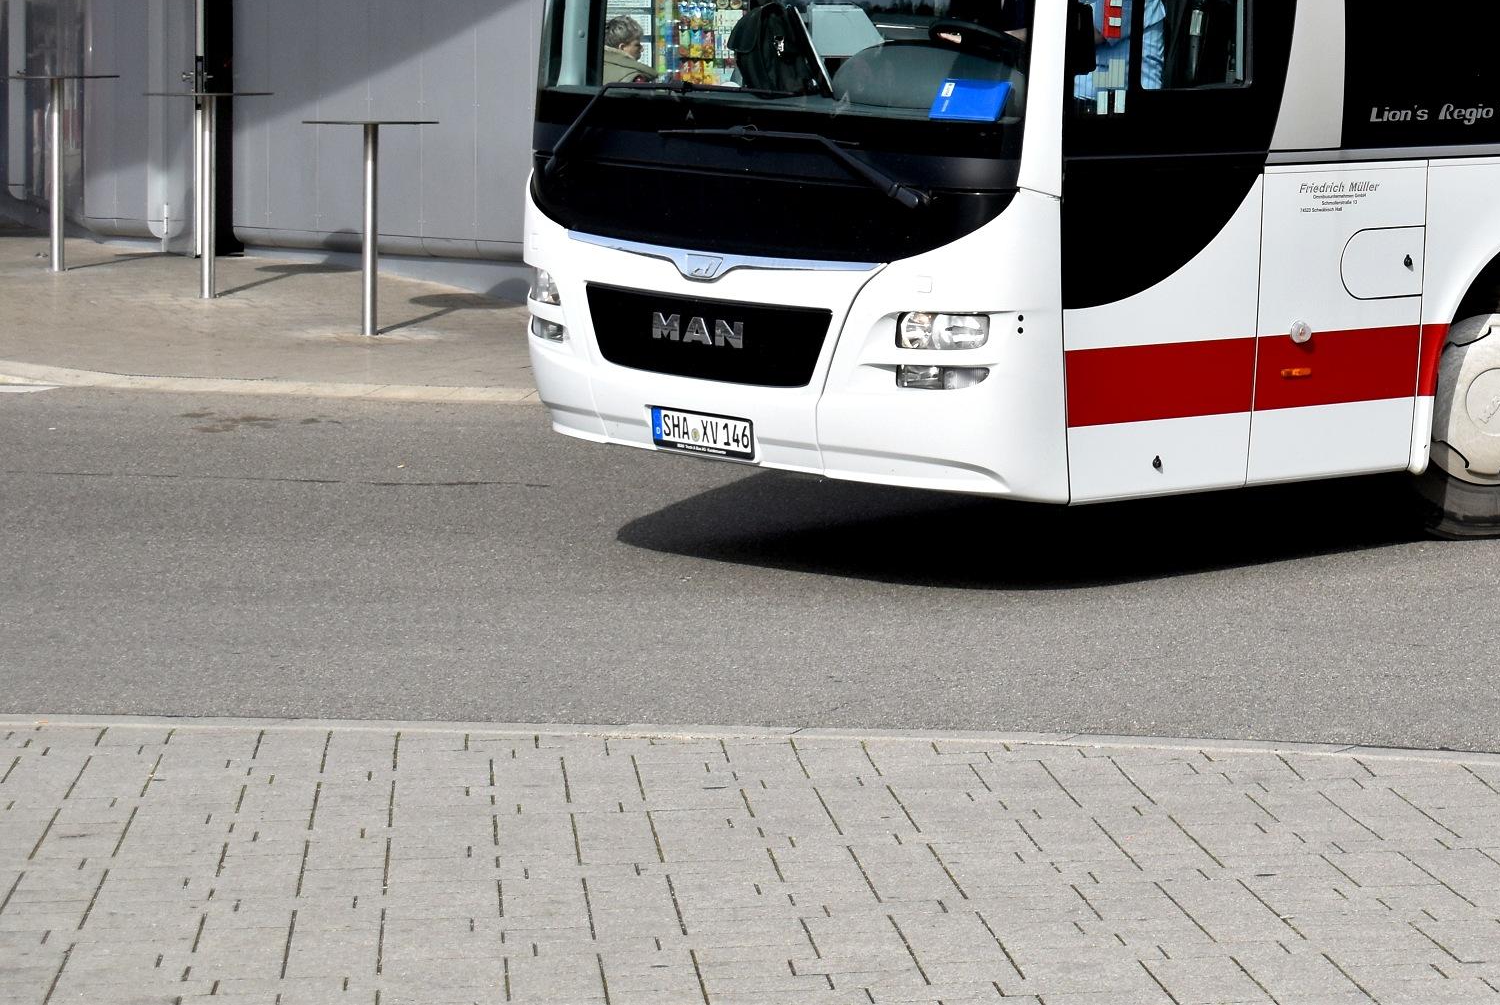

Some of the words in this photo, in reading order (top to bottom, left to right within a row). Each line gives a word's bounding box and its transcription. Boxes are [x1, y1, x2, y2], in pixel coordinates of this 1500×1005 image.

[1370, 105, 1429, 122] Lion's
[1438, 103, 1494, 125] Regio
[1299, 182, 1345, 193] Friedrich
[1349, 181, 1380, 192] Müller
[652, 311, 744, 348] MAN
[663, 413, 690, 440] SHA
[701, 419, 718, 444] XV
[722, 422, 750, 449] 146
